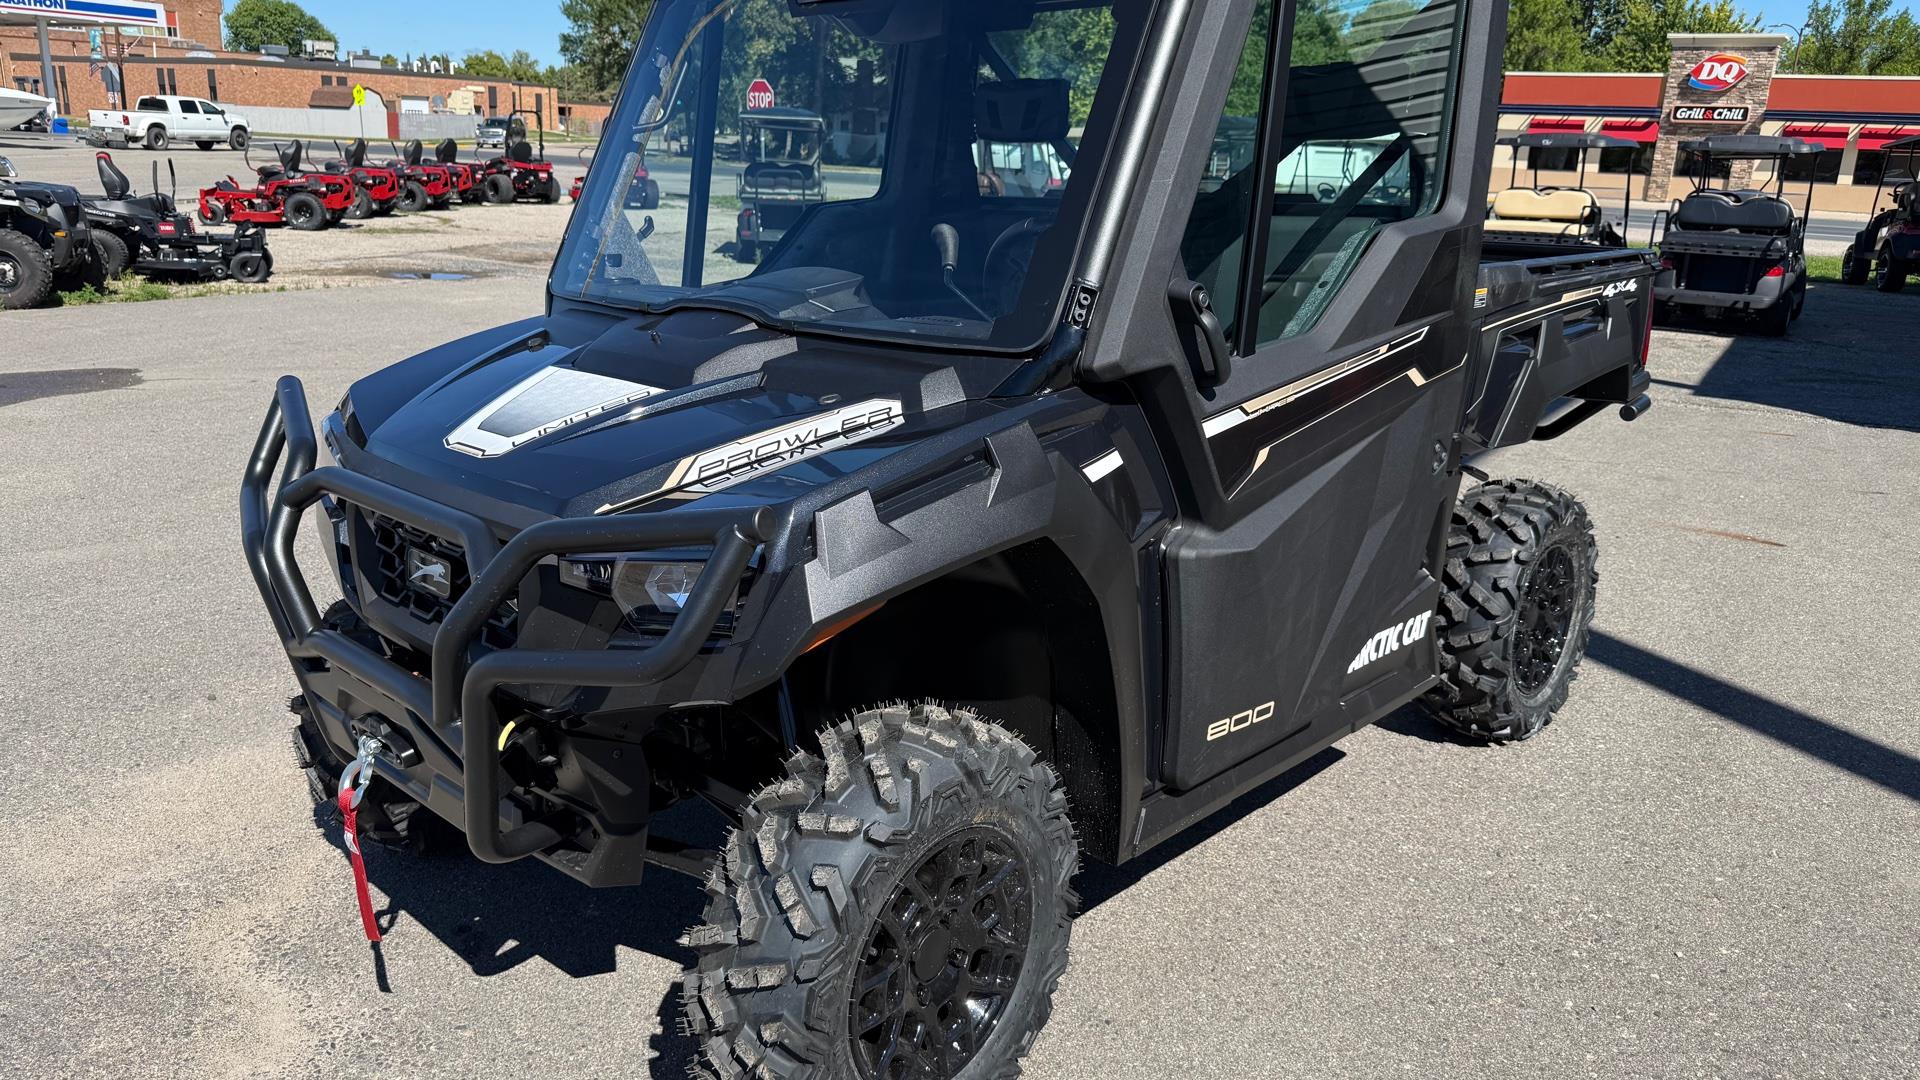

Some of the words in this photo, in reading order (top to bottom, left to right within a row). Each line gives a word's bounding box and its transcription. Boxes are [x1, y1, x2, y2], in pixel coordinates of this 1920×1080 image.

[0, 0, 64, 10] ATHON
[1697, 61, 1740, 83] DQ
[749, 92, 771, 108] STOP
[512, 390, 650, 448] LIMITED
[697, 406, 893, 480] PROWLER
[1347, 622, 1403, 674] ARCTIC
[1402, 610, 1432, 646] CAT
[1207, 701, 1275, 741] 800
